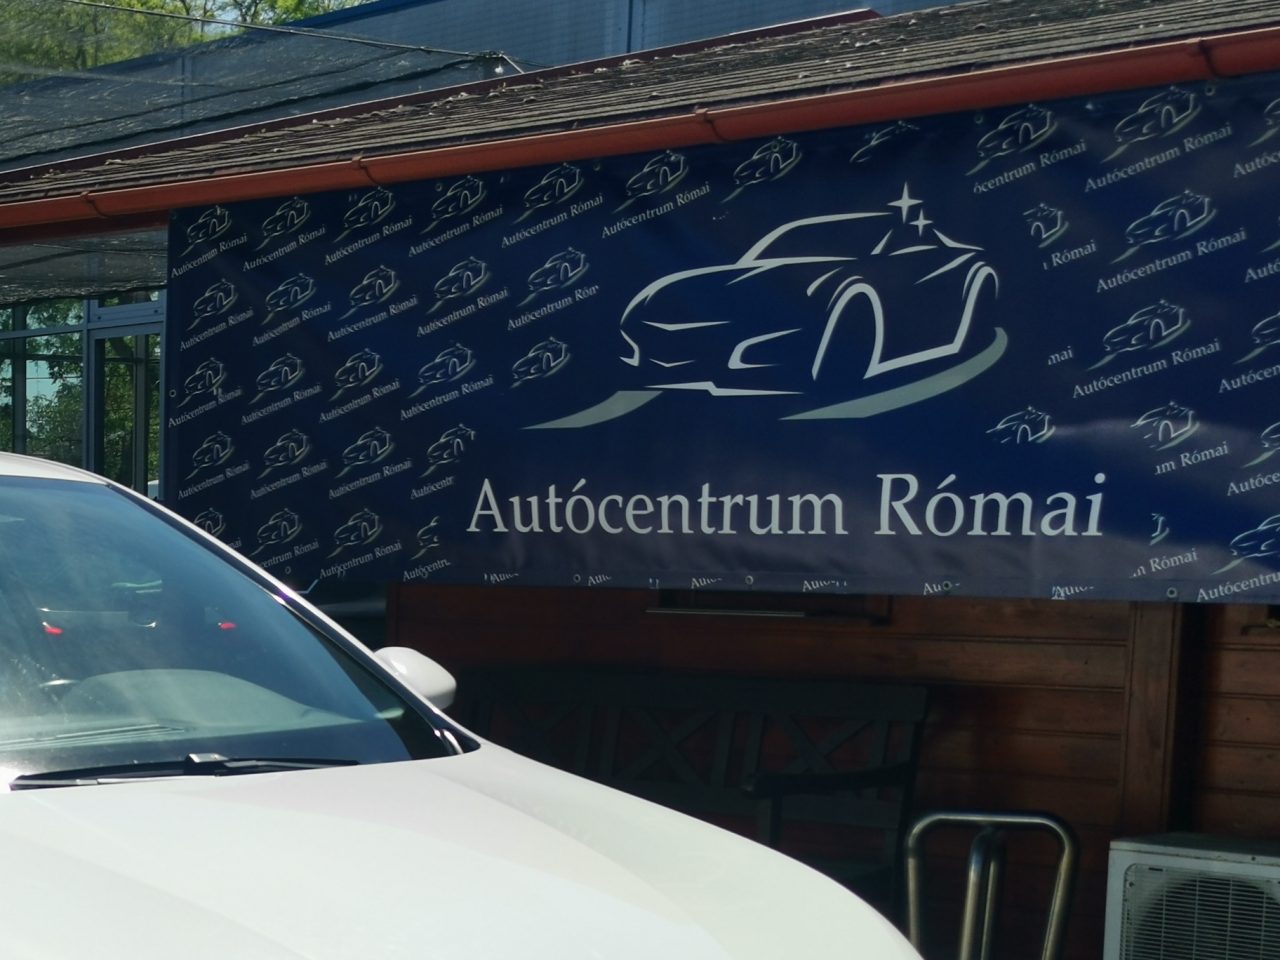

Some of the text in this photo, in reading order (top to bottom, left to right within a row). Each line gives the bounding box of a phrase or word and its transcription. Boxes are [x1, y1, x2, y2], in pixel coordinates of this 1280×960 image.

[1040, 139, 1087, 168] Római
[1084, 122, 1233, 193] Autócentrum Római
[501, 193, 604, 249] Autócentrum Római
[602, 181, 710, 239] Autócentrum Római
[408, 222, 470, 257] Autócentrum
[1051, 239, 1098, 267] Római
[1096, 227, 1248, 293] Autócentrum Római
[417, 303, 476, 337] Autócentrum
[507, 296, 572, 331] Autócentrum
[1072, 337, 1221, 399] Autócentrum Római
[1180, 441, 1229, 467] Római
[466, 473, 1107, 537] Autócentrum Római
[1149, 547, 1199, 573] Római
